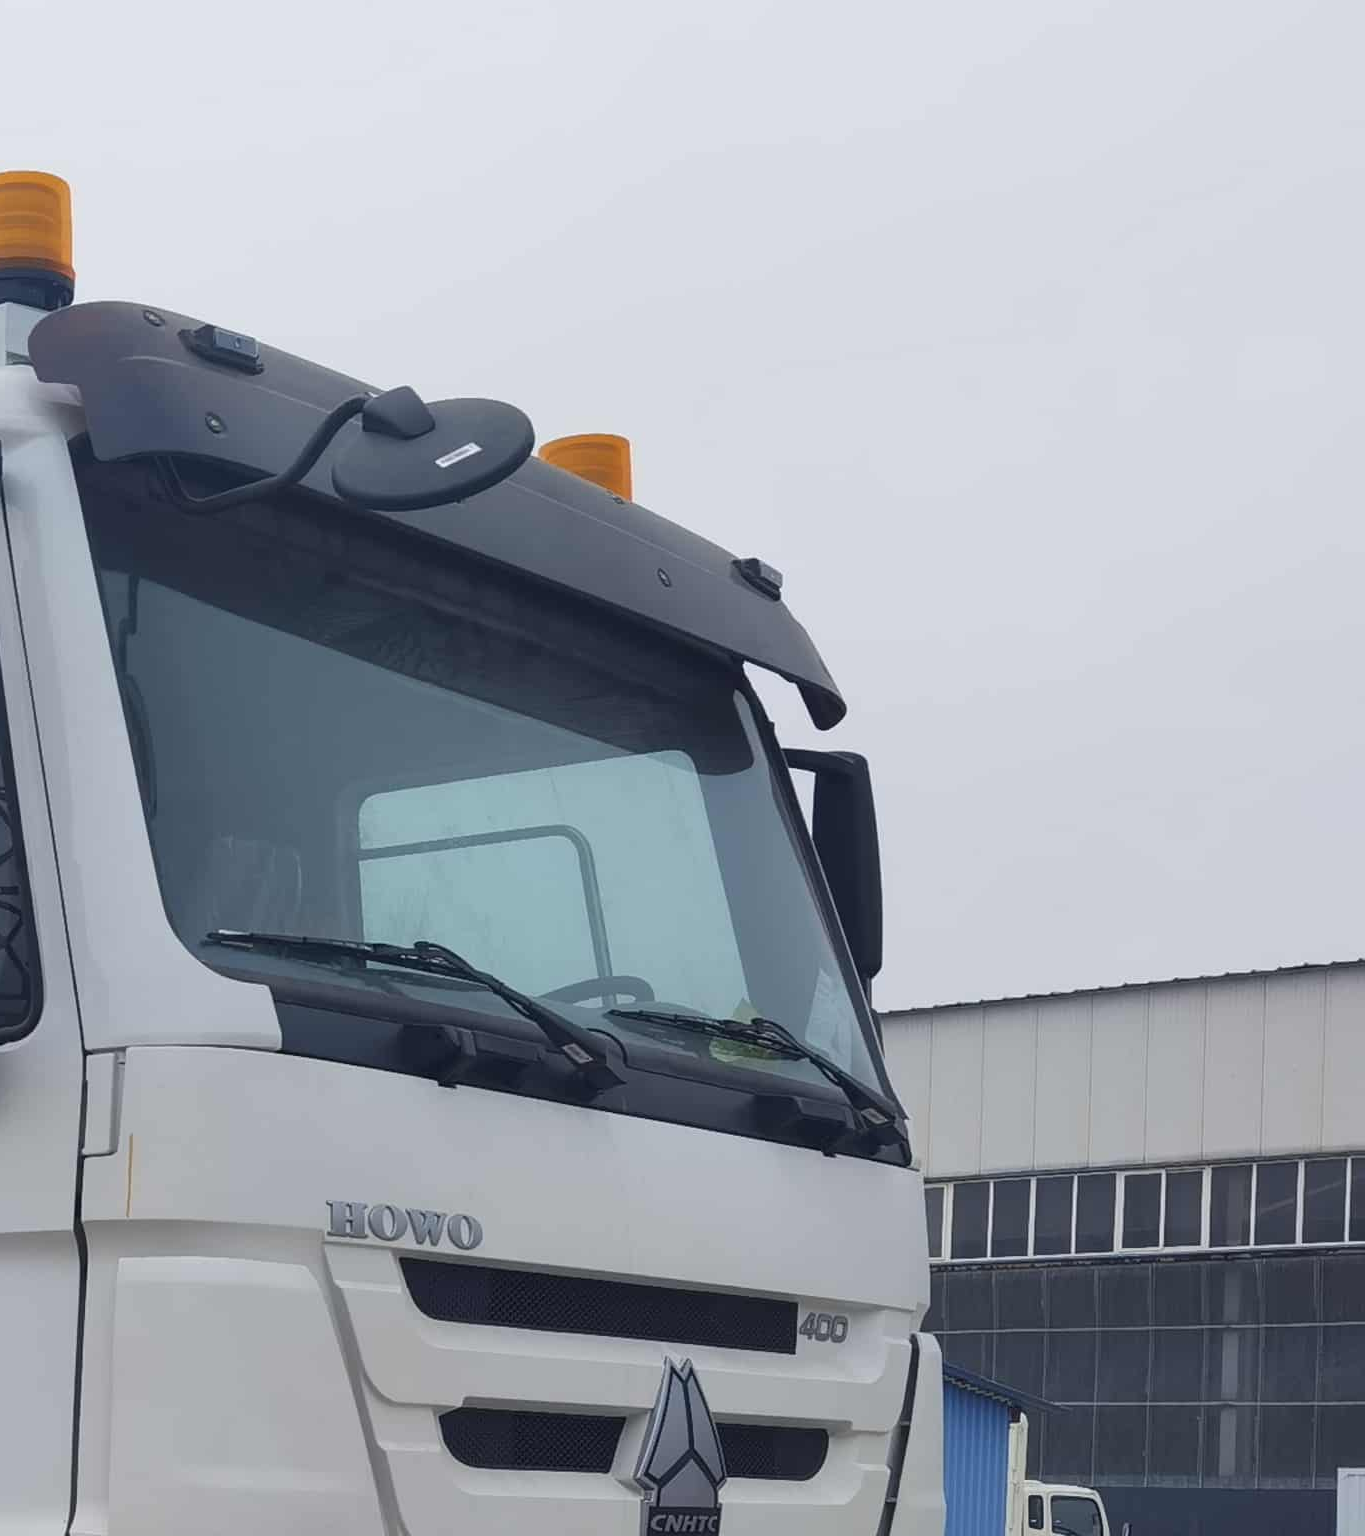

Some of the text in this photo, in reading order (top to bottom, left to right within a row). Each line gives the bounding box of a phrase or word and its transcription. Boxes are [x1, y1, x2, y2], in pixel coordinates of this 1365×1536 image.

[325, 1200, 484, 1251] HOWO
[798, 1311, 849, 1344] 400
[649, 1513, 718, 1533] CNHTC
